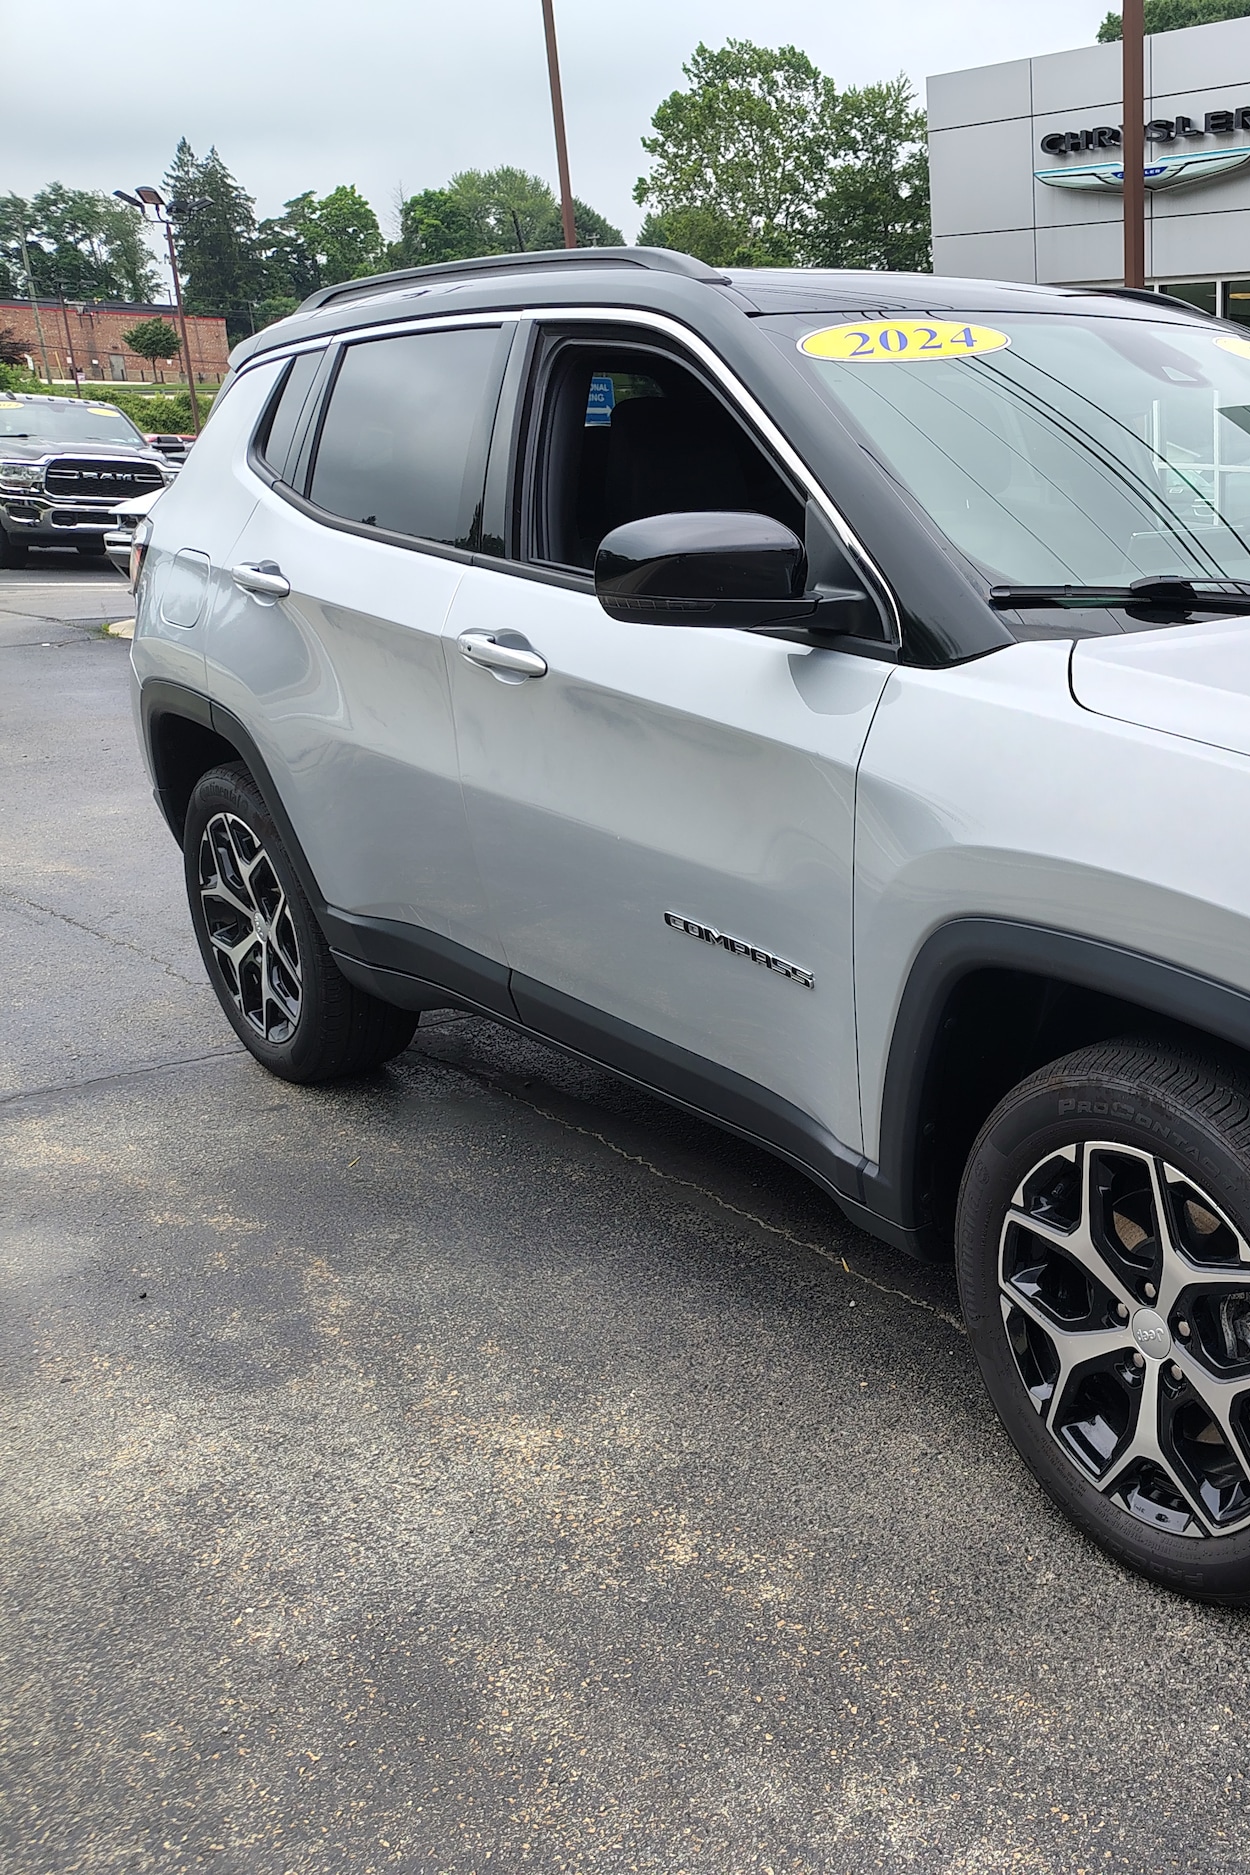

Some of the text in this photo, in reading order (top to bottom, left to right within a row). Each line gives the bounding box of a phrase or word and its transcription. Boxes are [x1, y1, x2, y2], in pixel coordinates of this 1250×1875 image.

[1116, 168, 1161, 178] CLER
[844, 327, 977, 357] 2024
[81, 471, 133, 481] RAM
[663, 910, 815, 990] COMPASS
[1136, 1327, 1164, 1342] Jeep
